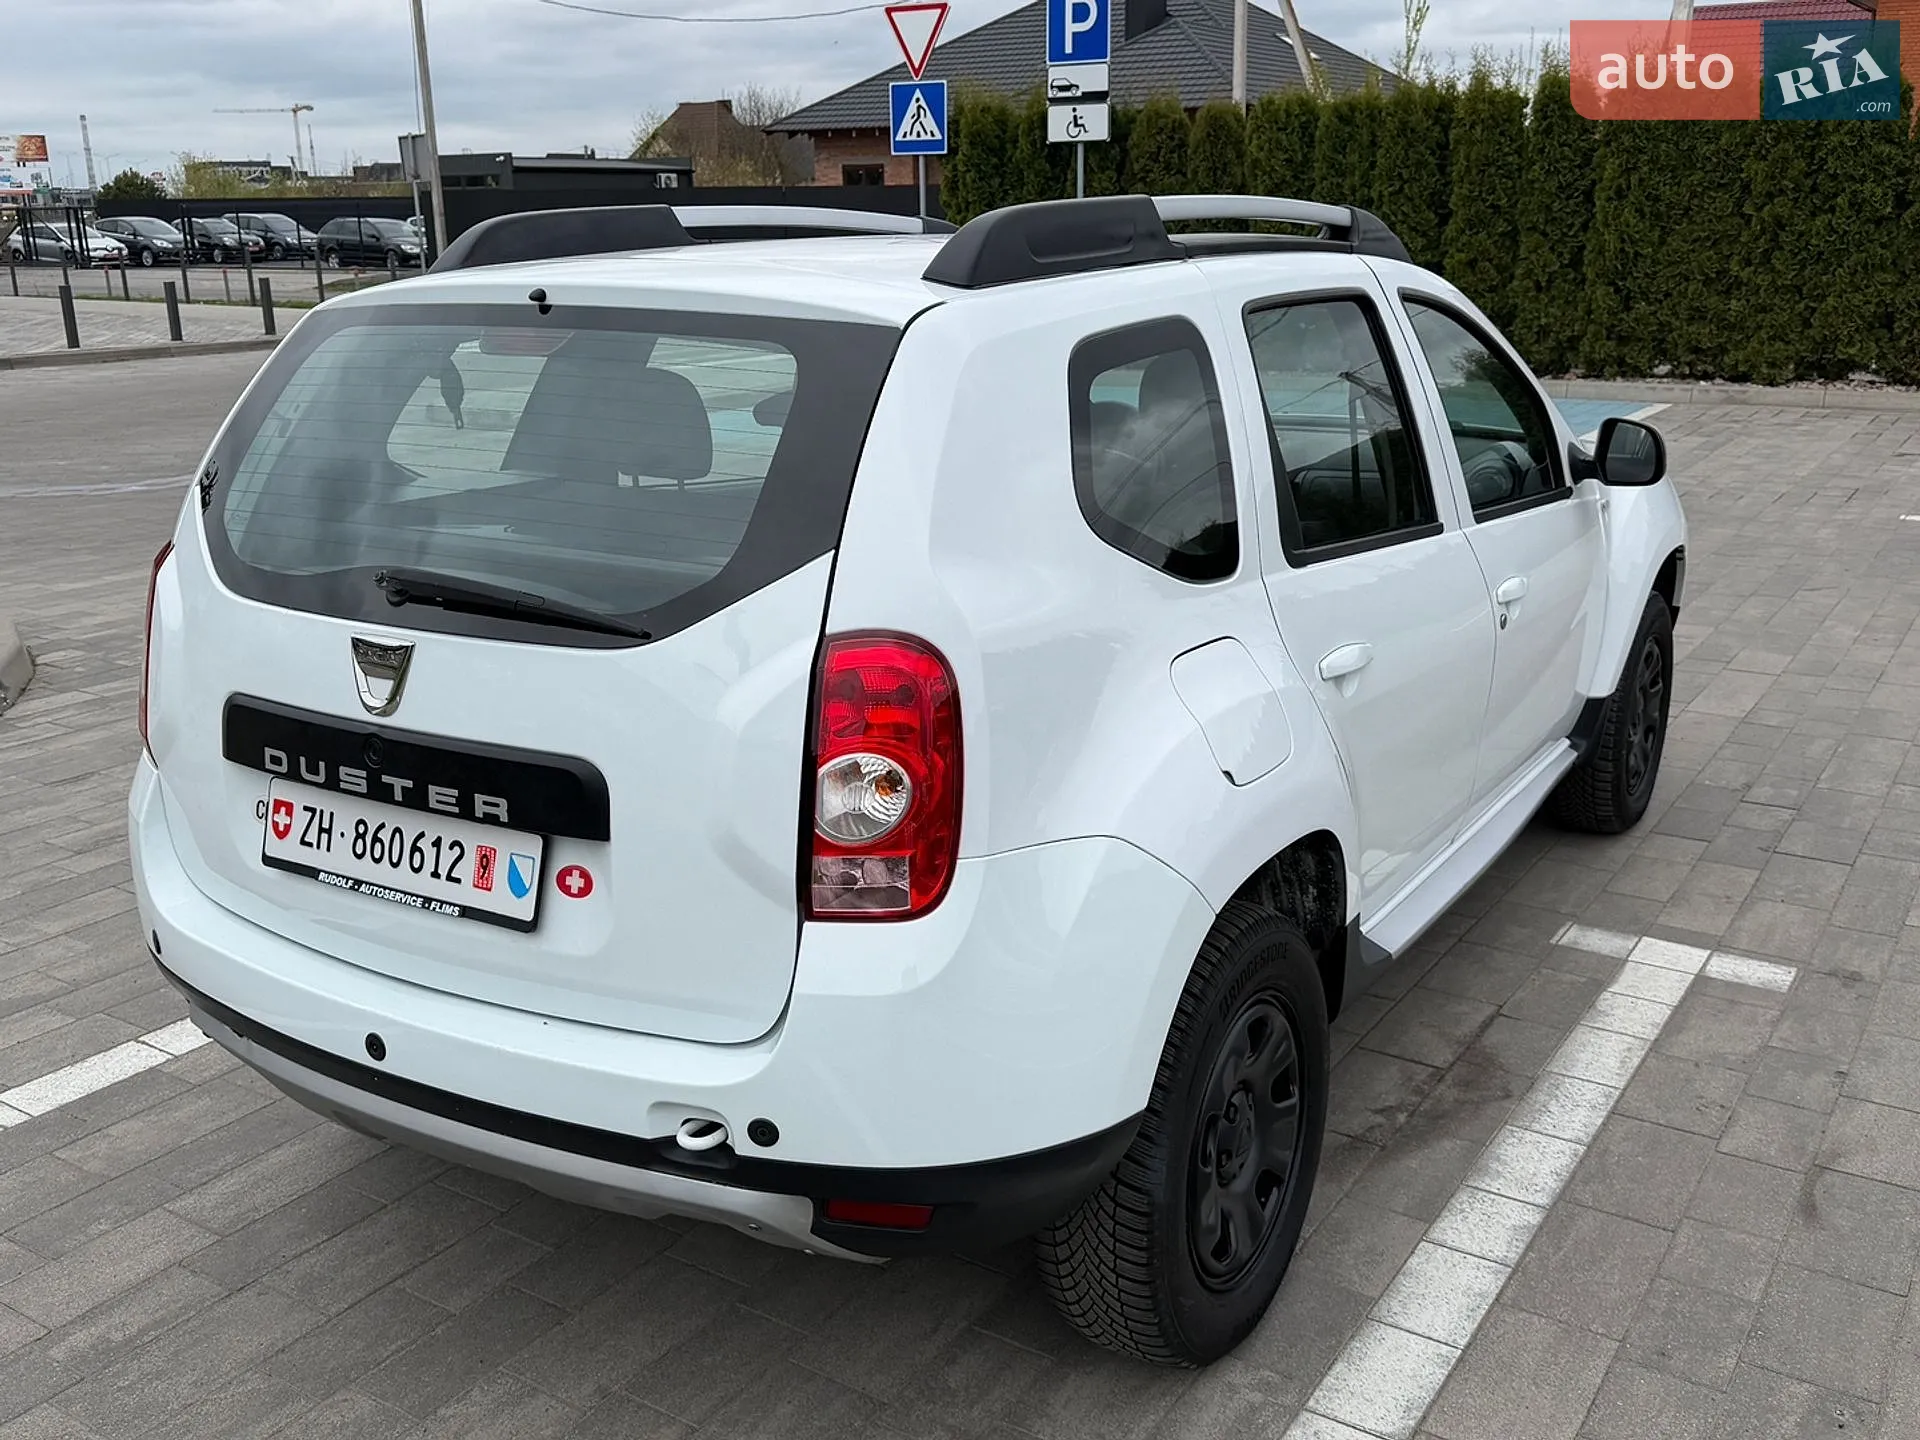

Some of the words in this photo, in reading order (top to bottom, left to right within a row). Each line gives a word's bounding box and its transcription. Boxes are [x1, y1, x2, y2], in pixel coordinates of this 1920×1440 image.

[1064, 0, 1098, 54] P
[264, 746, 509, 823] DUSTER
[318, 871, 355, 890] RUDOLF
[359, 883, 424, 908] AUTOSERVICE
[430, 901, 460, 917] FLIMS
[1219, 941, 1290, 1022] BRIDGESTONE
